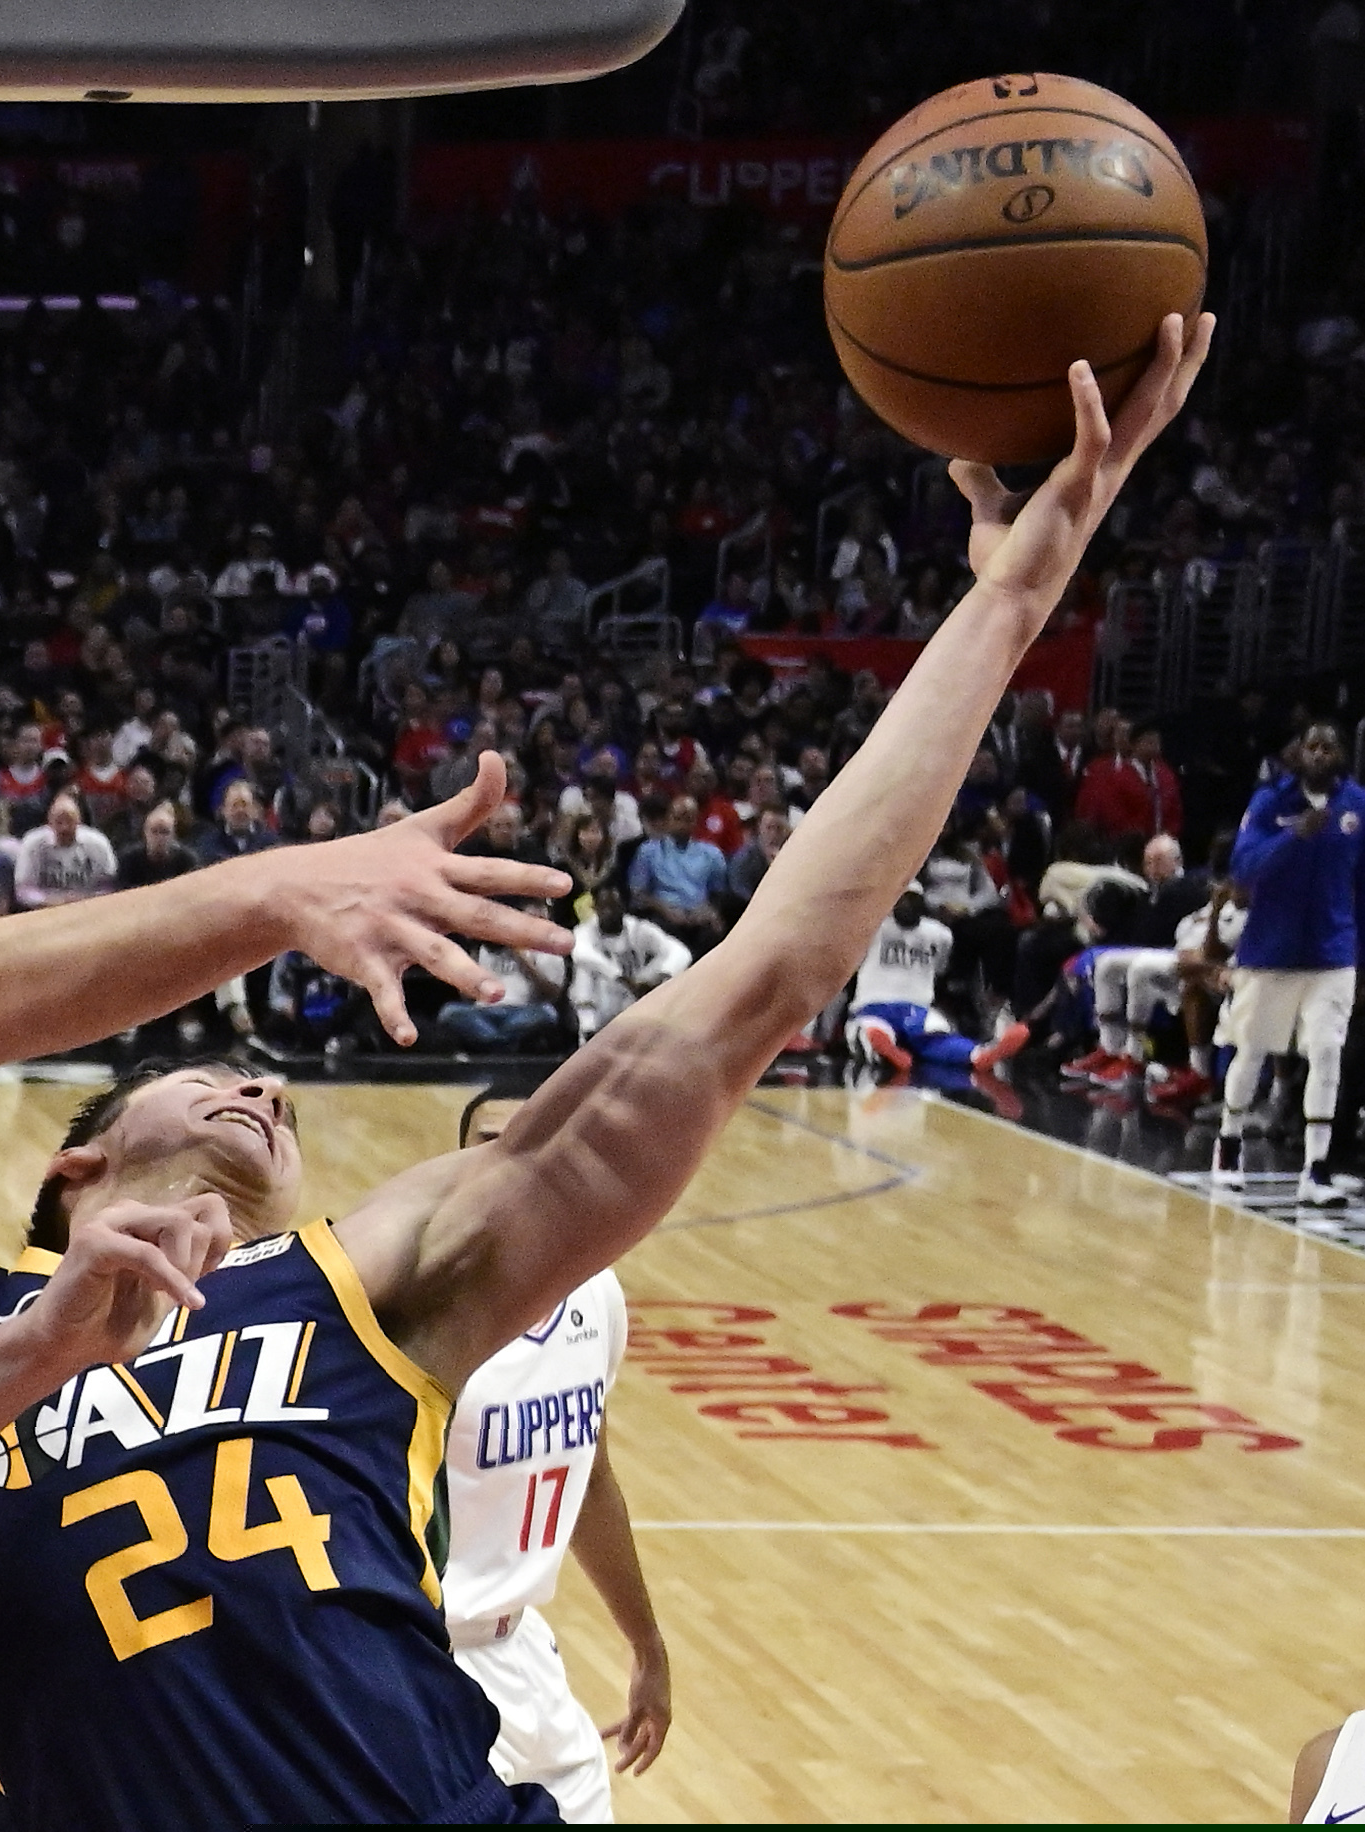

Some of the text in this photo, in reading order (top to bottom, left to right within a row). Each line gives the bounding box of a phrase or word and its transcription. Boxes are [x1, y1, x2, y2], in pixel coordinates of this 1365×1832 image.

[893, 138, 1154, 220] SPALDING
[828, 1302, 1304, 1452] STAPLES
[60, 1436, 341, 1663] 24
[518, 1464, 571, 1553] 17
